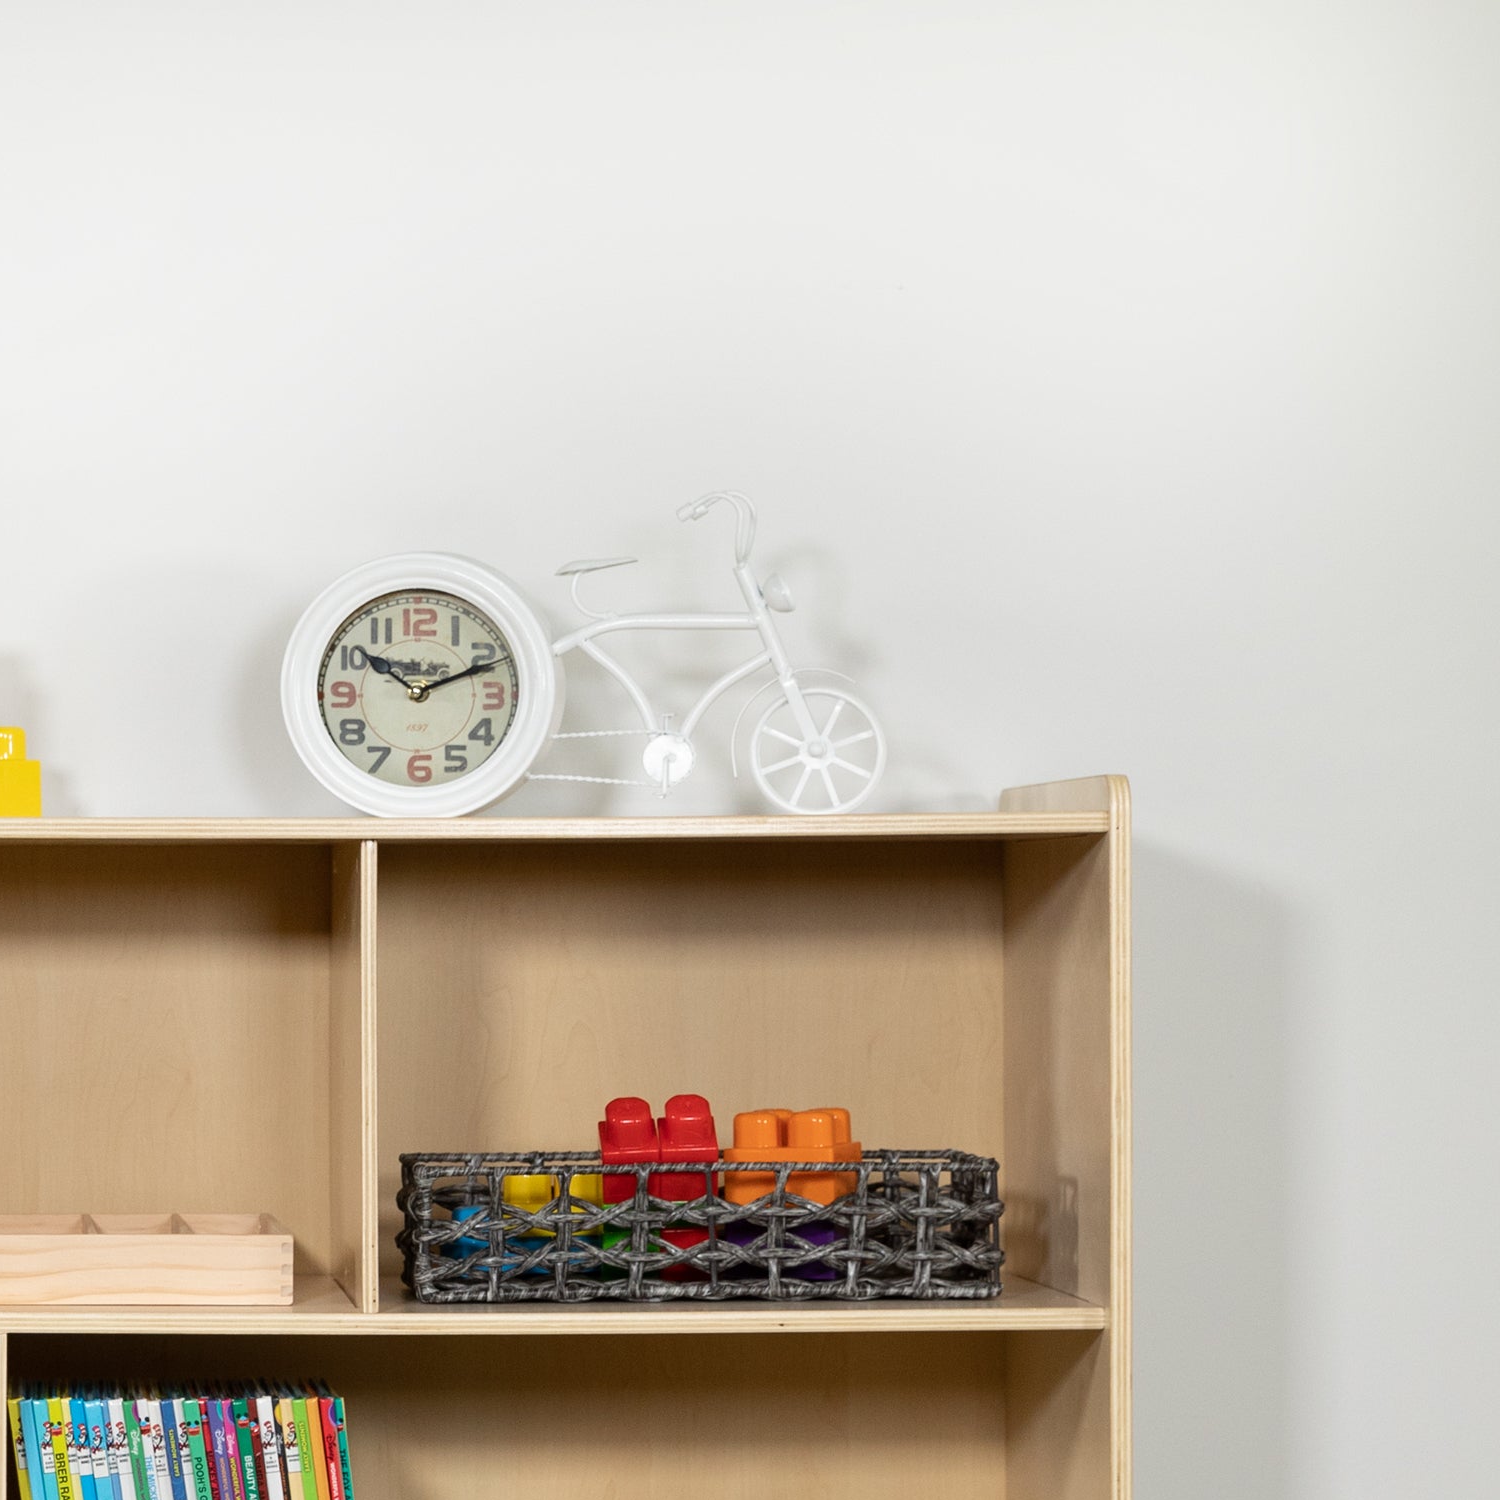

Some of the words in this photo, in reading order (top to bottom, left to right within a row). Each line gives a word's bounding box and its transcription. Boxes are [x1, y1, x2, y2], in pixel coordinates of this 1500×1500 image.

[370, 617, 392, 644] 11
[402, 608, 438, 637] 12
[452, 615, 459, 646] 1
[340, 645, 367, 671] 10
[471, 642, 496, 674] 2
[330, 681, 356, 708] 9
[482, 682, 505, 710] 3
[339, 719, 366, 746] 8
[468, 718, 495, 746] 4
[367, 746, 391, 774] 7
[407, 754, 432, 783] 6
[444, 745, 467, 772] 5
[127, 1427, 142, 1455] Disney
[212, 1427, 227, 1454] Disney
[55, 1453, 68, 1482] BRER
[144, 1455, 154, 1472] THE
[193, 1456, 206, 1492] POOH'S
[229, 1457, 240, 1494] WONDERFUL
[243, 1455, 255, 1490] BEAUTY
